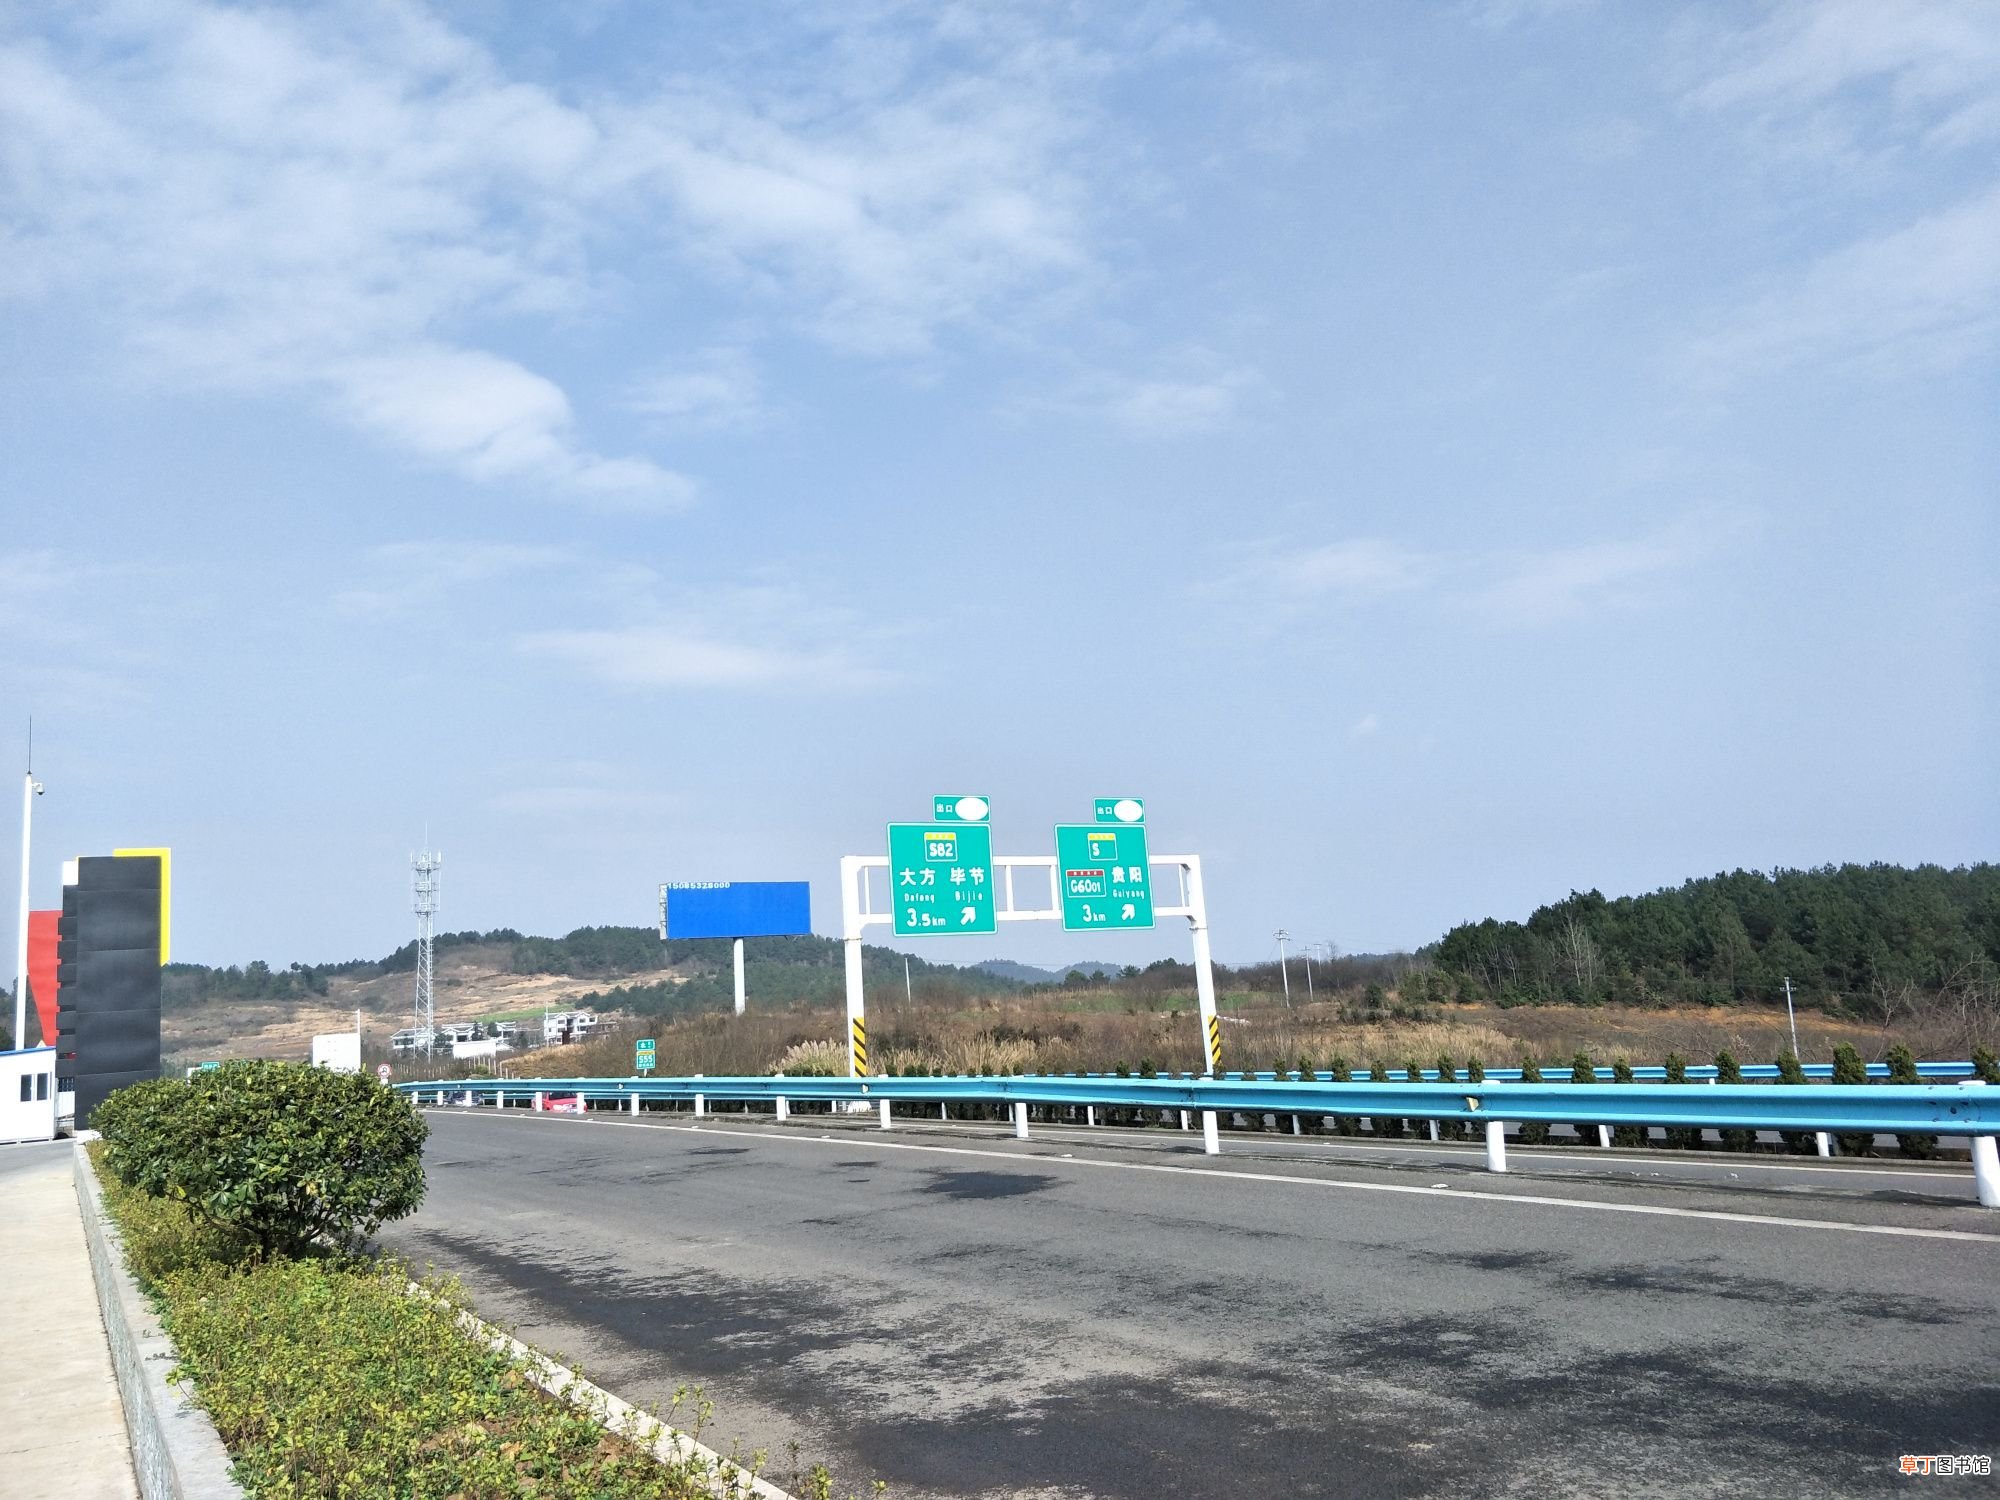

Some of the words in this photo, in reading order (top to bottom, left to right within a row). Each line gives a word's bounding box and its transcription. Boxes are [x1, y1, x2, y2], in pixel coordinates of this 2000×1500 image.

[929, 843, 953, 857] S82
[1092, 843, 1100, 856] S
[899, 867, 936, 886] 大方
[950, 867, 985, 886] 毕节
[1071, 880, 1101, 893] G6001
[955, 891, 983, 903] Bijie
[1113, 889, 1144, 899] Guiyang
[907, 908, 946, 927] 3.5km
[1082, 904, 1106, 922] 3km
